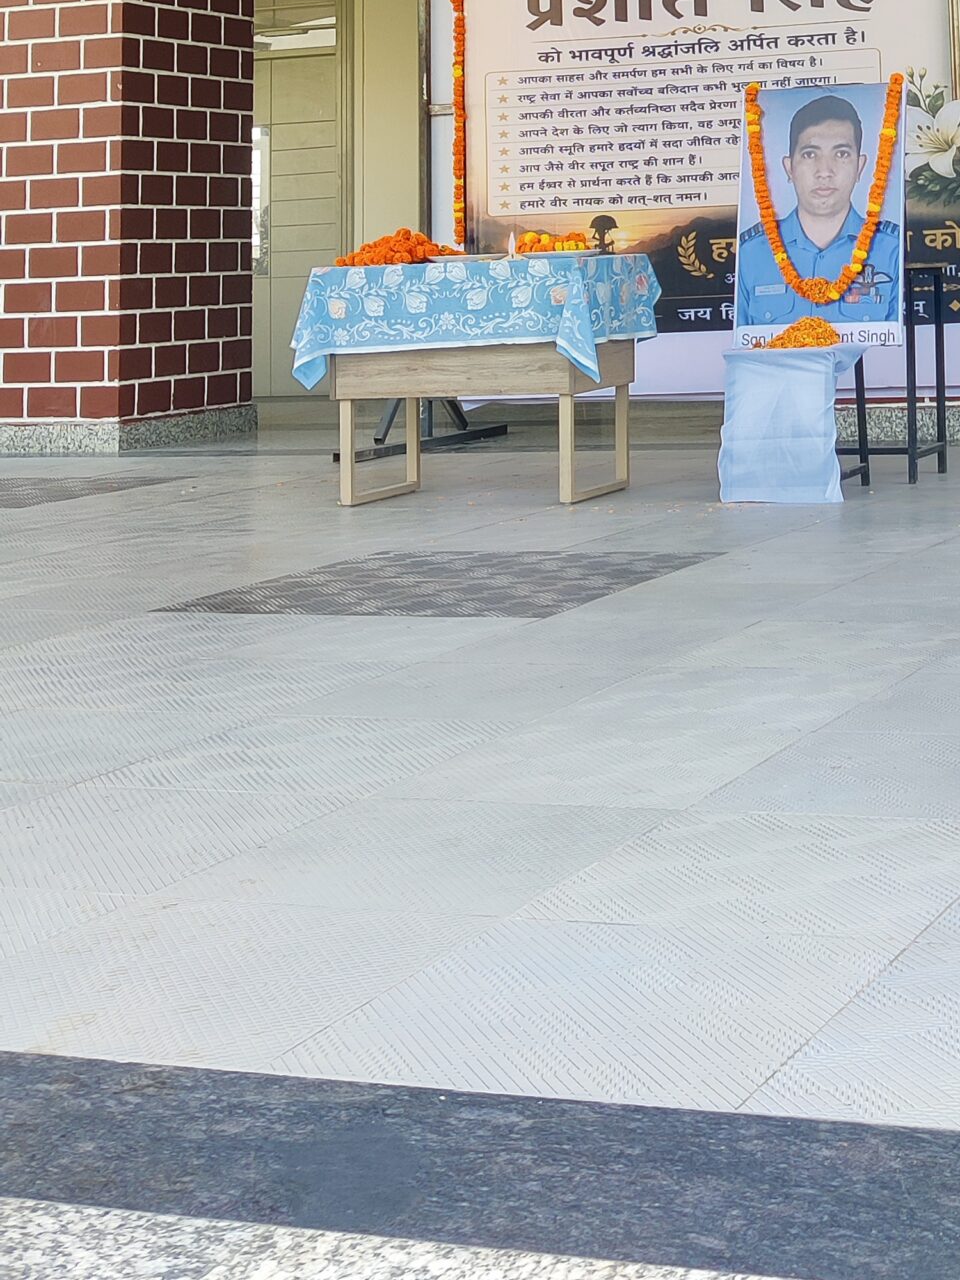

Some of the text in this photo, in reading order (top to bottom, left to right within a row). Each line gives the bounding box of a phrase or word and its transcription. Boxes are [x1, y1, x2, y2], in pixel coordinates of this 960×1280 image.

[537, 47, 563, 64] को
[569, 42, 635, 64] भावपूर्ण
[641, 37, 720, 59] श्रद्धांजलि
[728, 33, 780, 51] अर्पित
[787, 32, 837, 47] करता
[518, 76, 552, 84] आपका
[556, 73, 584, 83] साहस
[588, 70, 608, 80] और
[612, 68, 648, 80] समर्पण
[651, 69, 667, 78] हम
[670, 65, 693, 76] सभी
[696, 64, 709, 74] के
[712, 63, 734, 73] लिए
[738, 60, 754, 71] गर्व
[758, 61, 773, 70] का
[776, 58, 805, 68] विषय
[517, 94, 536, 104] राष्ट्र
[540, 91, 561, 102] सेवा
[564, 90, 574, 100] में
[577, 90, 613, 99] आपका
[657, 83, 699, 94] बलिदान
[703, 80, 727, 91] कभी
[772, 76, 791, 88] नहीं
[518, 108, 553, 120] आपकी
[557, 108, 587, 118] वीरता
[591, 106, 611, 117] और
[680, 100, 705, 112] सदैव
[709, 99, 737, 110] प्रेरणा
[518, 127, 548, 138] आपने
[552, 126, 569, 137] देश
[573, 125, 584, 135] के
[588, 124, 610, 135] लिए
[614, 122, 628, 133] जो
[632, 123, 657, 132] त्याग
[697, 120, 713, 129] वह
[519, 144, 554, 155] आपकी
[589, 141, 614, 153] हमारे
[649, 139, 658, 149] में
[662, 139, 682, 149] सदा
[687, 135, 722, 146] जीवित
[725, 133, 741, 145] रहे
[519, 164, 540, 173] आप
[544, 161, 564, 171] जैसे
[568, 159, 585, 170] वीर
[589, 161, 614, 171] सपूत
[618, 160, 639, 170] राष्ट्र
[643, 156, 658, 167] की
[662, 157, 684, 166] शान
[519, 182, 535, 191] हम
[567, 178, 576, 188] से
[580, 176, 612, 188] प्रार्थना
[616, 175, 641, 185] करते
[656, 173, 672, 184] कि
[676, 171, 713, 182] आपकी
[520, 197, 546, 210] हमारे
[550, 196, 568, 208] वीर
[572, 197, 604, 207] नायक
[608, 194, 623, 205] को
[677, 307, 713, 321] जय
[857, 329, 896, 346] Singh
